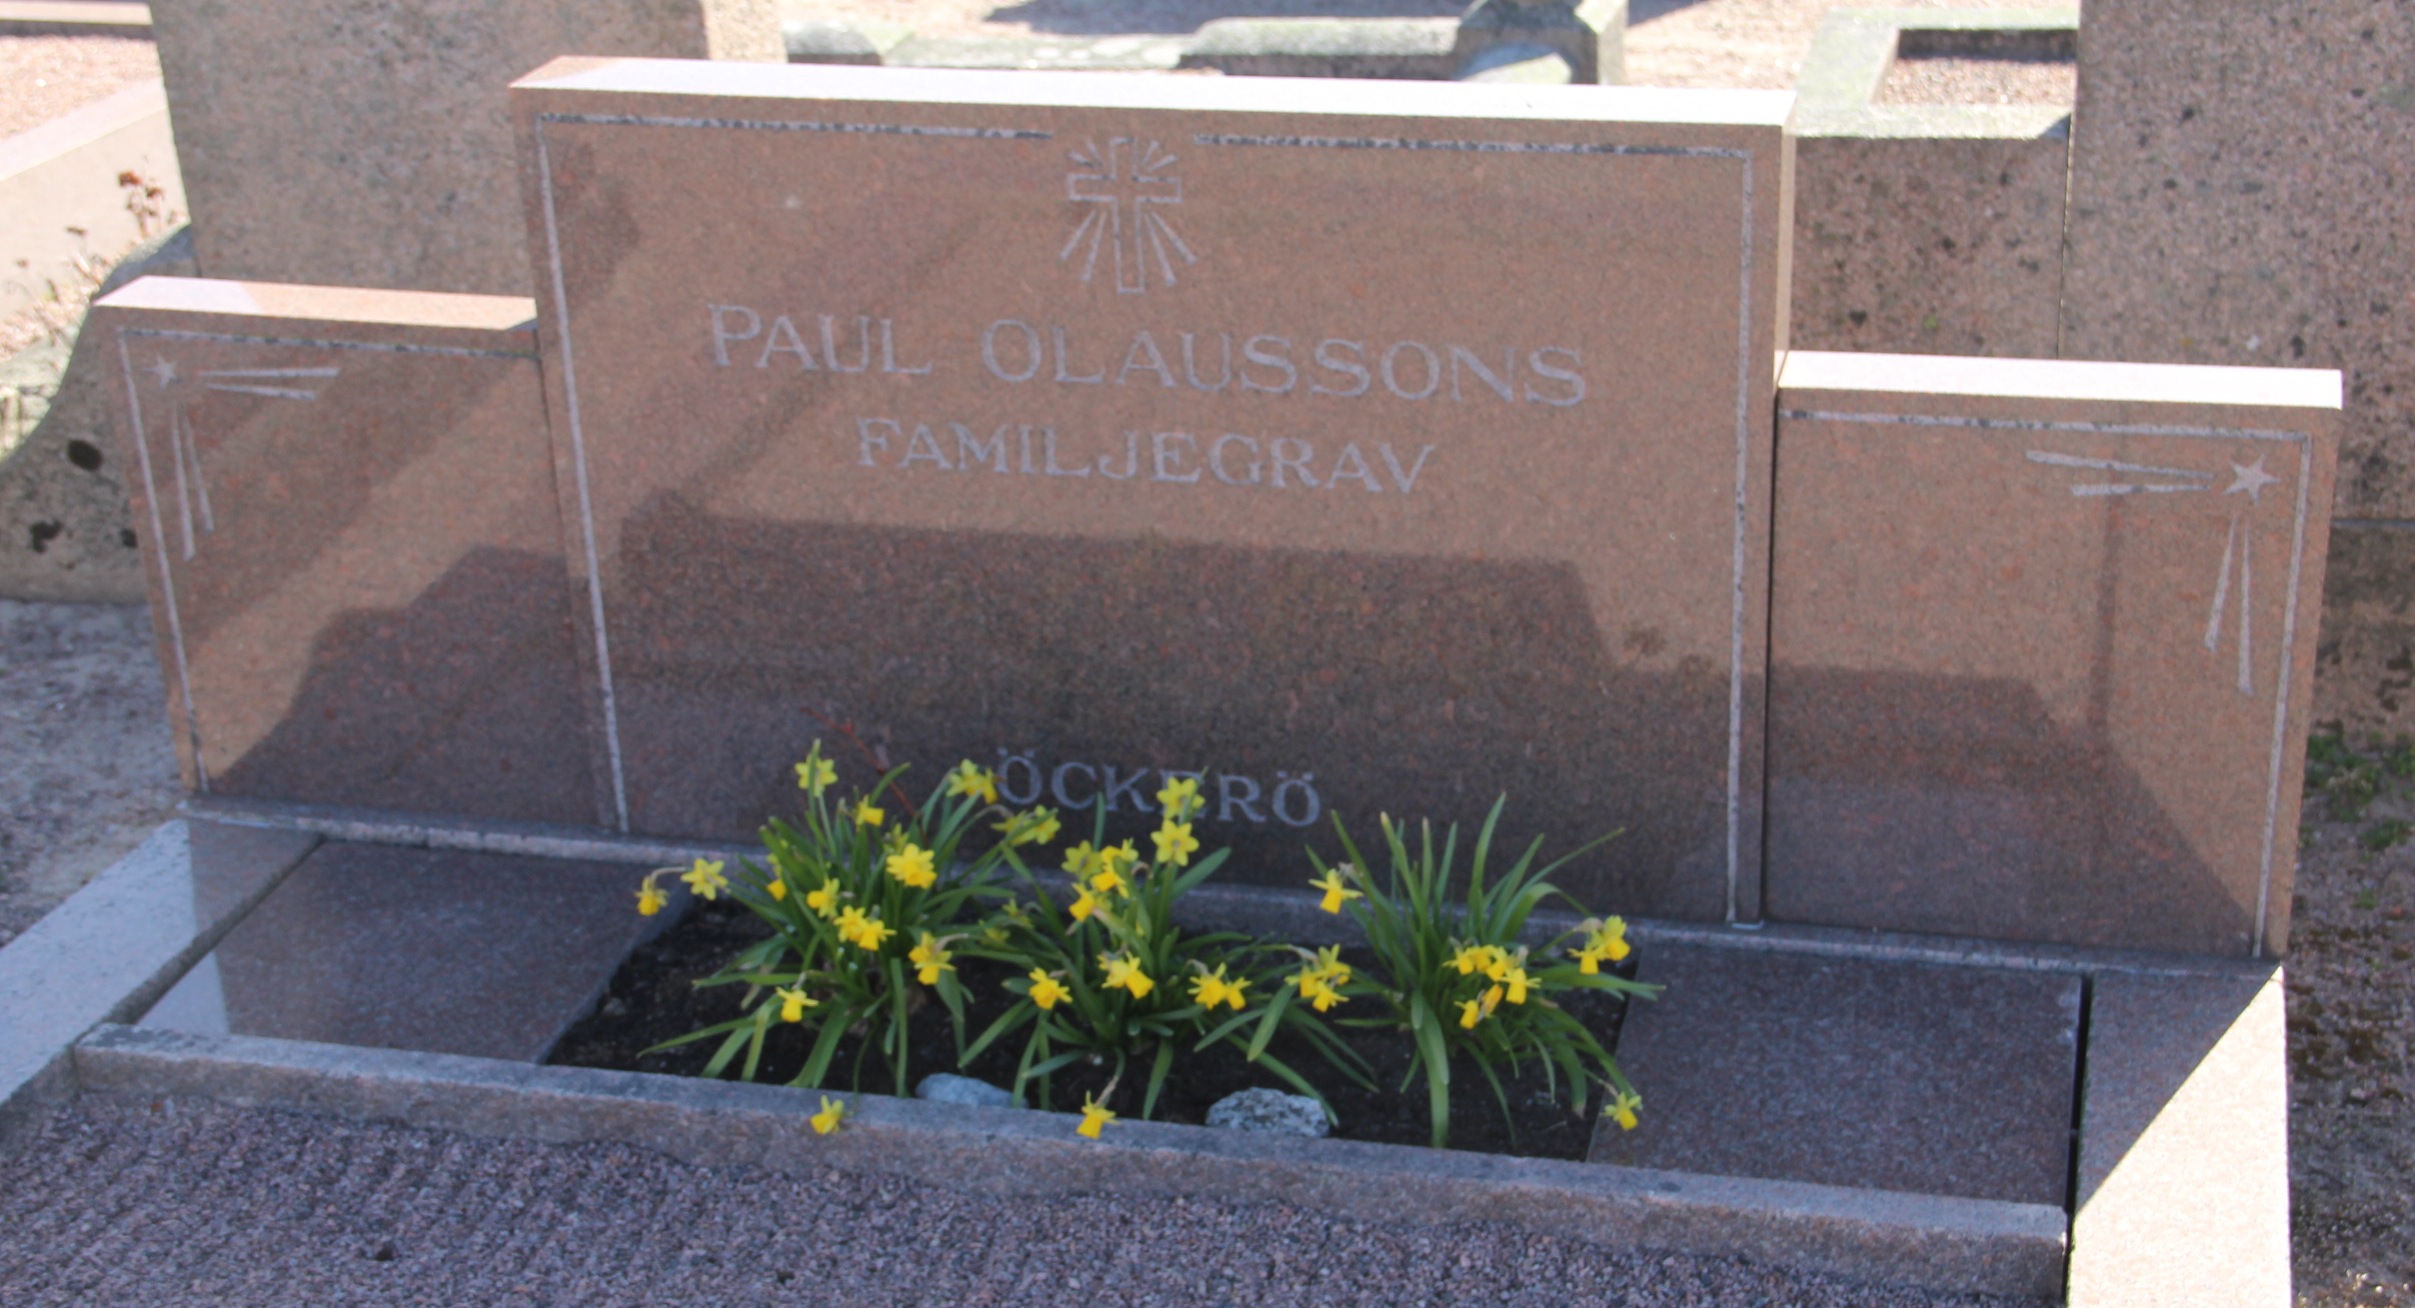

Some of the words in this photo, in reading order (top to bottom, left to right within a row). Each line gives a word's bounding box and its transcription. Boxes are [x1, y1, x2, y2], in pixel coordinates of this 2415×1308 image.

[706, 302, 933, 375] PAUL
[980, 318, 1588, 406] OLAUSSONS
[855, 417, 1436, 494] FAMILJEGRAV
